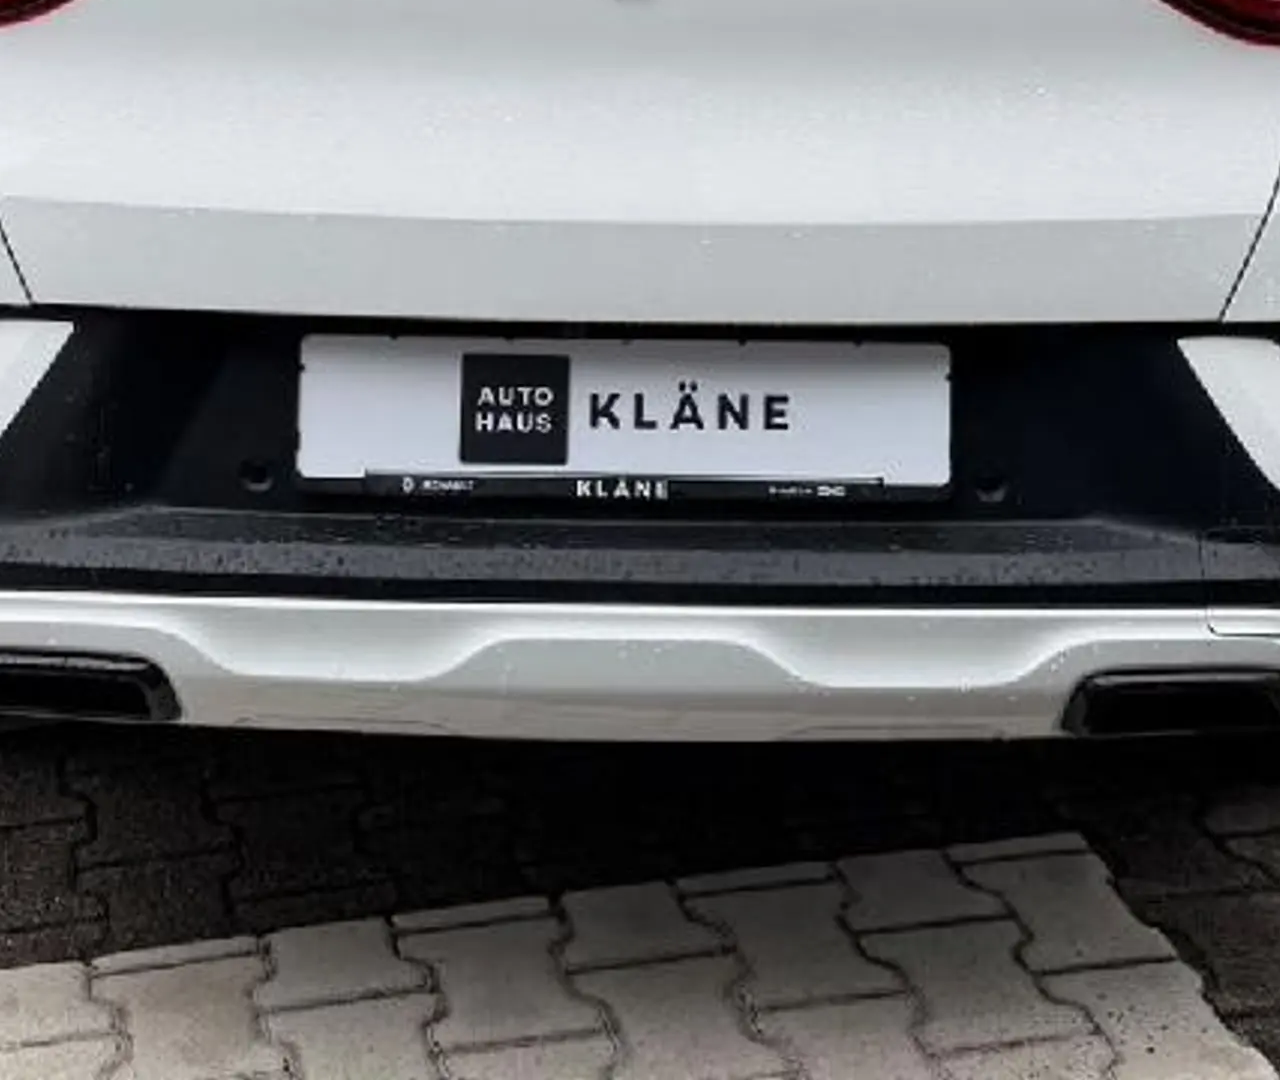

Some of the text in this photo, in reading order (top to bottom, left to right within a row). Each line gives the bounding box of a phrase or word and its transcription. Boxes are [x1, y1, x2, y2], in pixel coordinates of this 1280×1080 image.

[476, 386, 555, 407] AUTO
[589, 380, 790, 431] KLÄNE
[474, 411, 553, 434] HAUS
